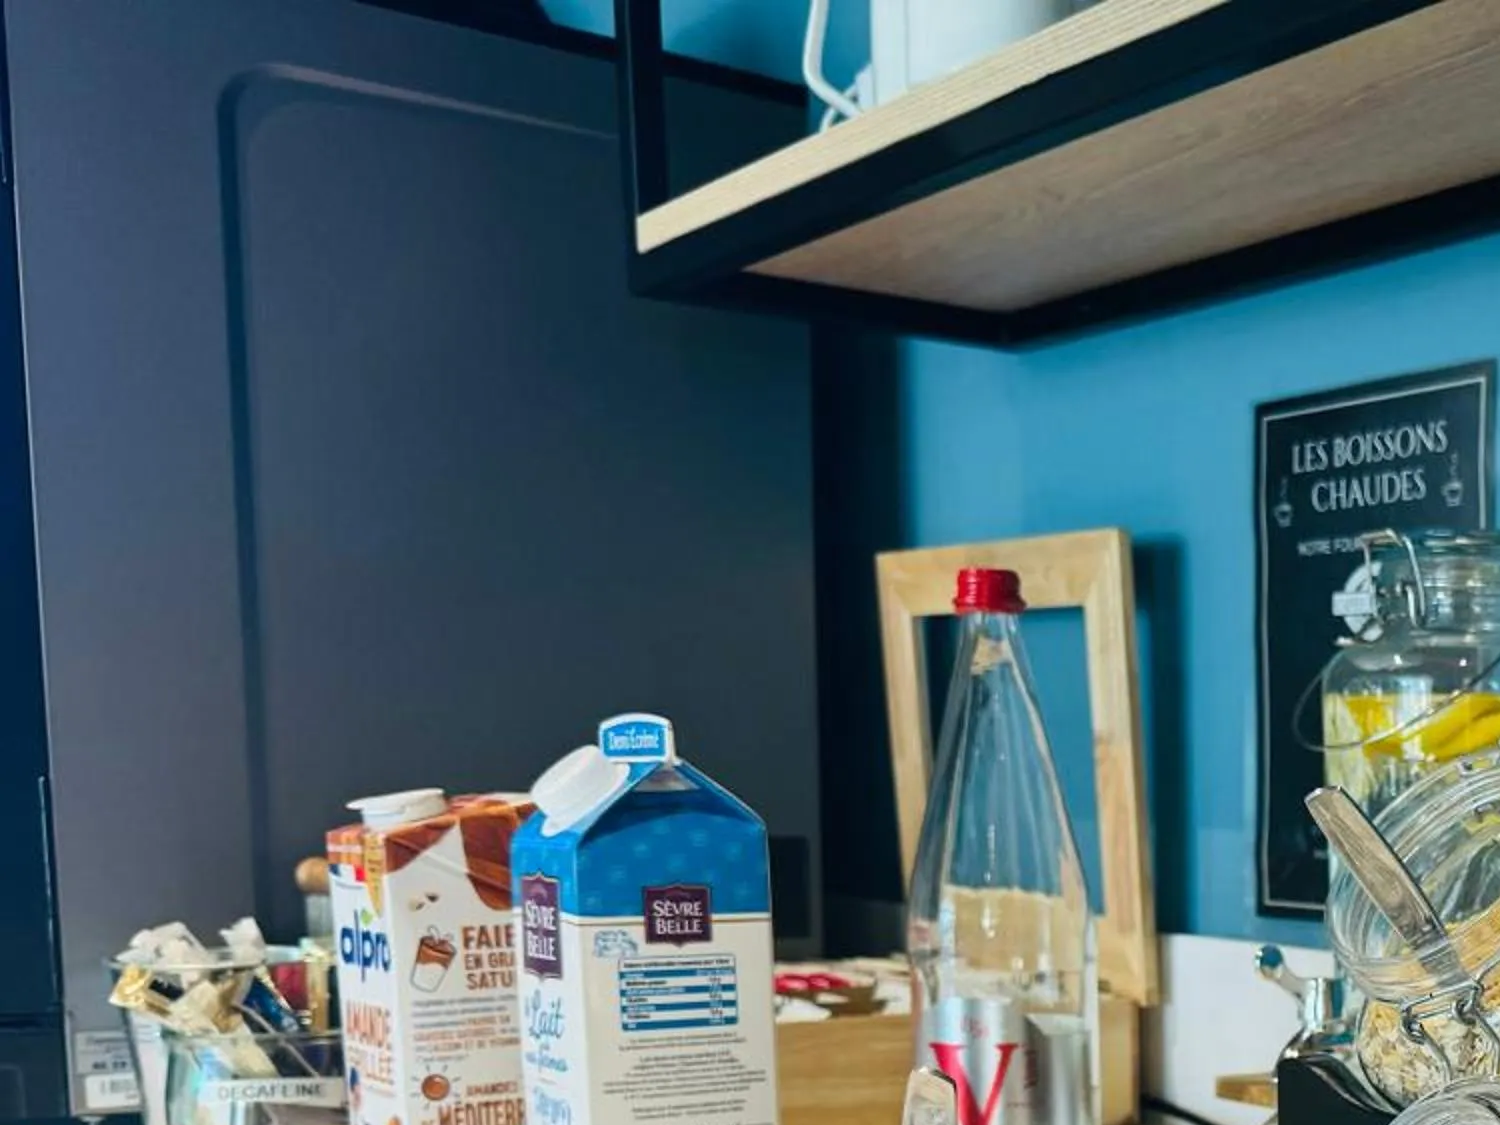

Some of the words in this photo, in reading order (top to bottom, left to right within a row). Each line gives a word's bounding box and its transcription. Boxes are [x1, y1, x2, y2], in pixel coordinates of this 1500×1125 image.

[1291, 440, 1329, 475] LES
[1333, 419, 1449, 469] BOISSONS
[1311, 469, 1428, 513] CHAUDES
[652, 899, 703, 918] SÈVRE
[655, 918, 703, 935] BELLE
[340, 909, 392, 983] alpro
[527, 930, 557, 961] BELLE
